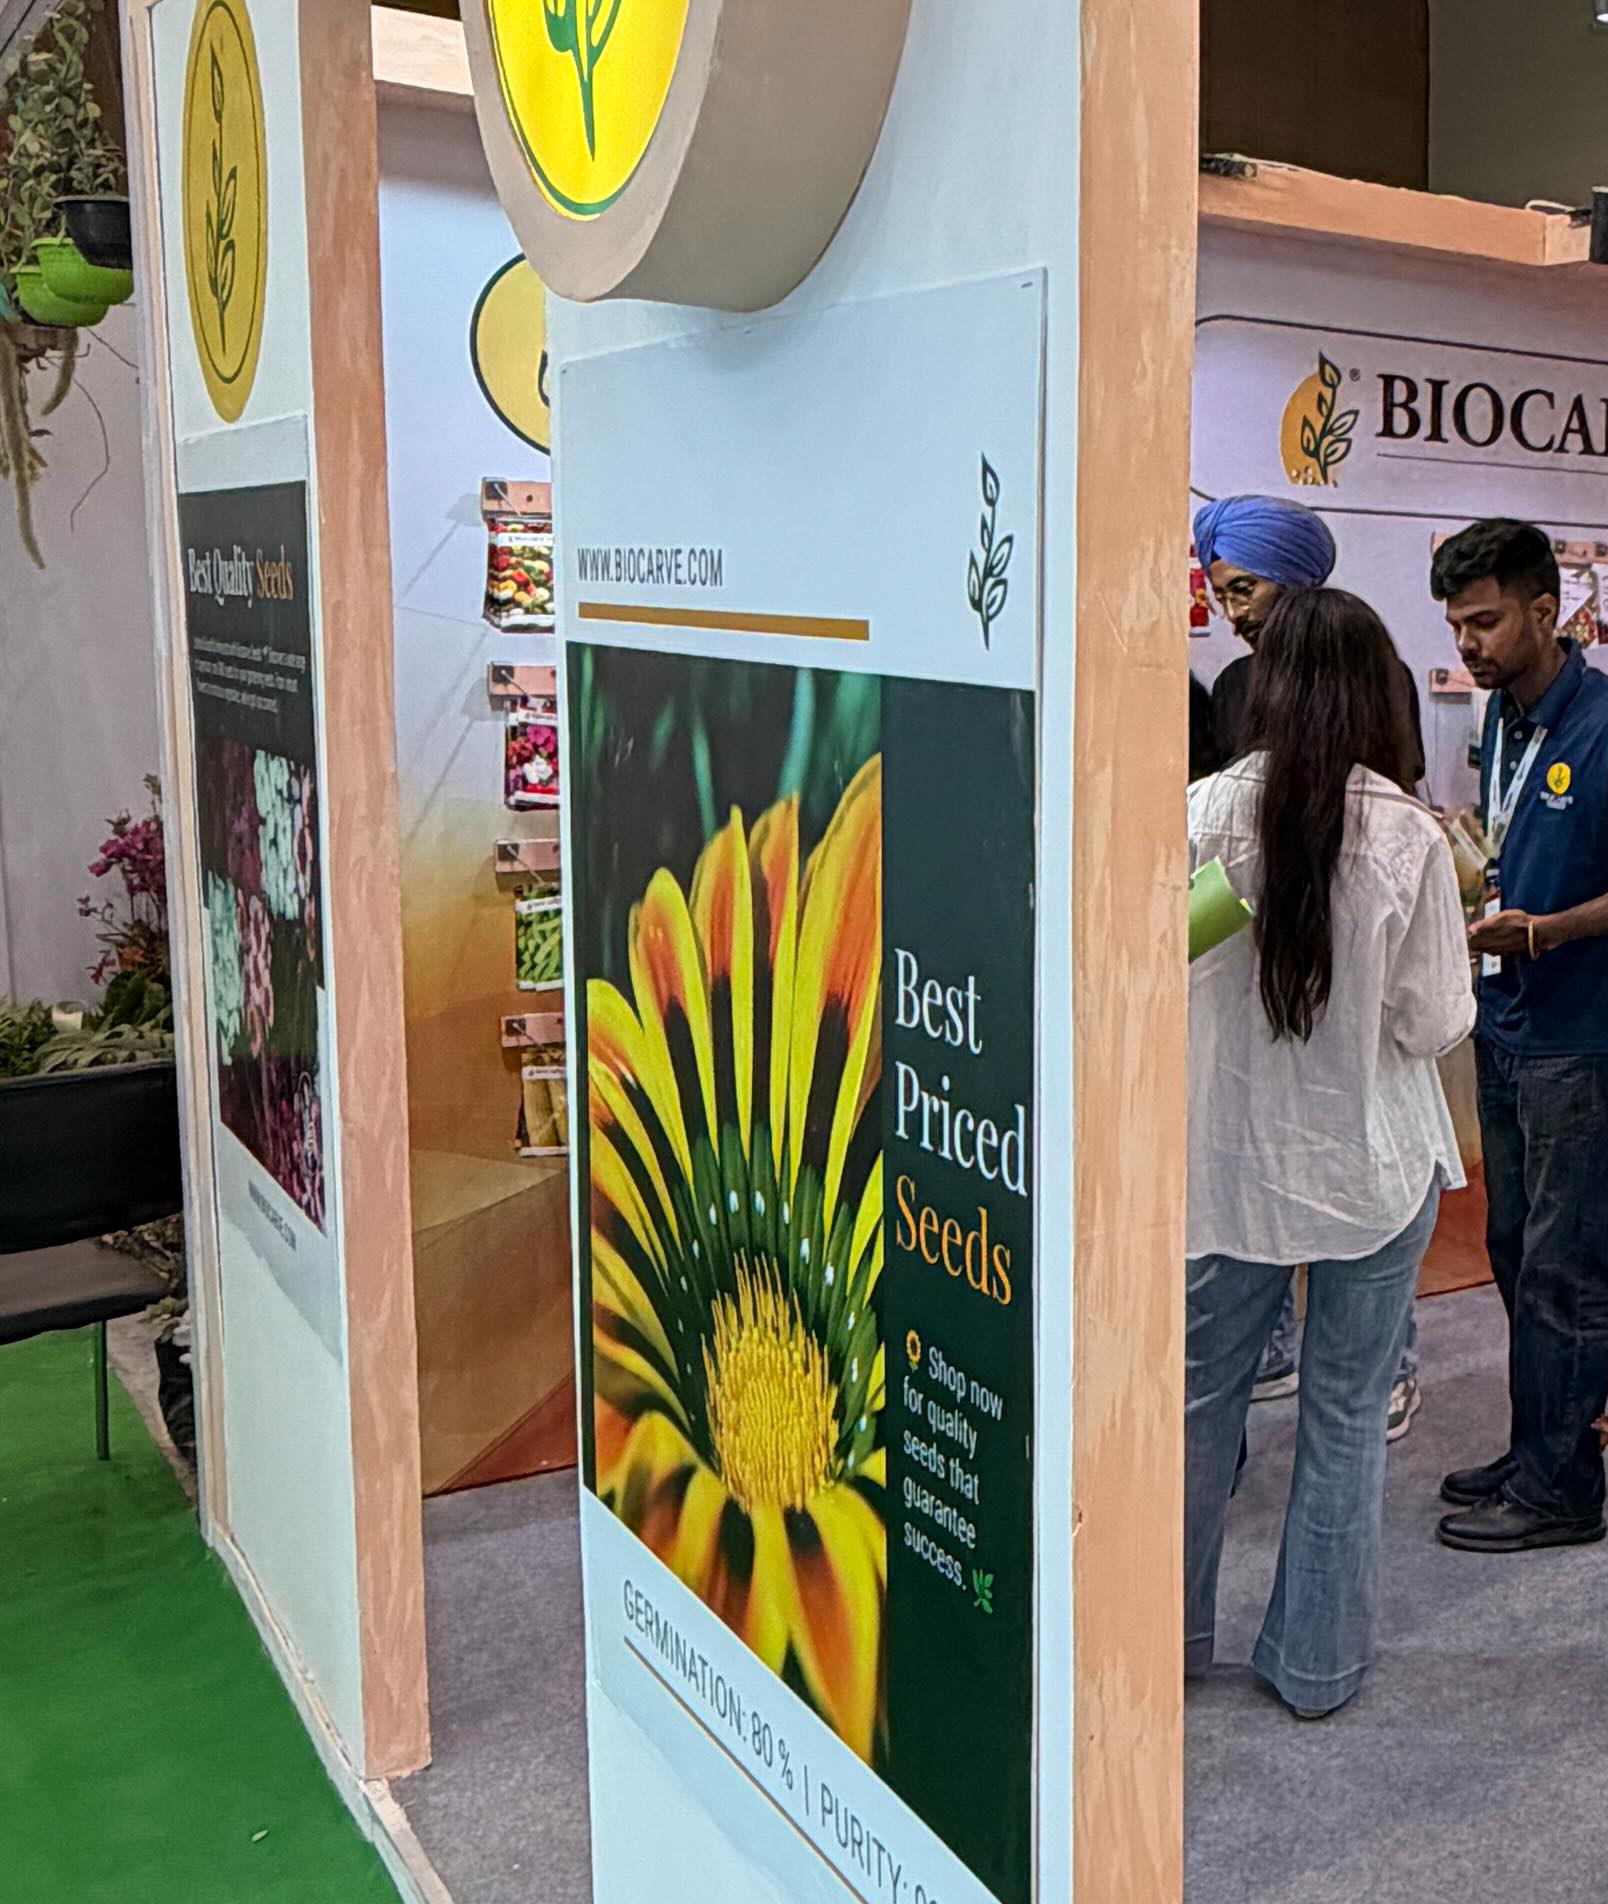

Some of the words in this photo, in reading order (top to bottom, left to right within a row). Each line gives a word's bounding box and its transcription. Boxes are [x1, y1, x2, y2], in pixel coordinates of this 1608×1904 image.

[188, 548, 212, 594] Best
[213, 544, 254, 608] Quality
[256, 544, 293, 600] Seeds
[577, 547, 723, 586] WWW.BIOCARVE.COM
[895, 947, 982, 1055] Best
[895, 1060, 1028, 1197] Priced
[896, 1174, 1011, 1305] Seeds
[903, 1375, 924, 1416] for
[927, 1399, 977, 1459] quality
[928, 1346, 966, 1402] Shop
[970, 1380, 1003, 1421] now
[903, 1429, 945, 1479] seeds
[949, 1457, 979, 1505] that
[903, 1476, 976, 1549] guarantee
[903, 1521, 967, 1591] success.
[623, 1579, 747, 1743] GERMINATION:
[751, 1711, 773, 1768] 80
[778, 1739, 793, 1790] %
